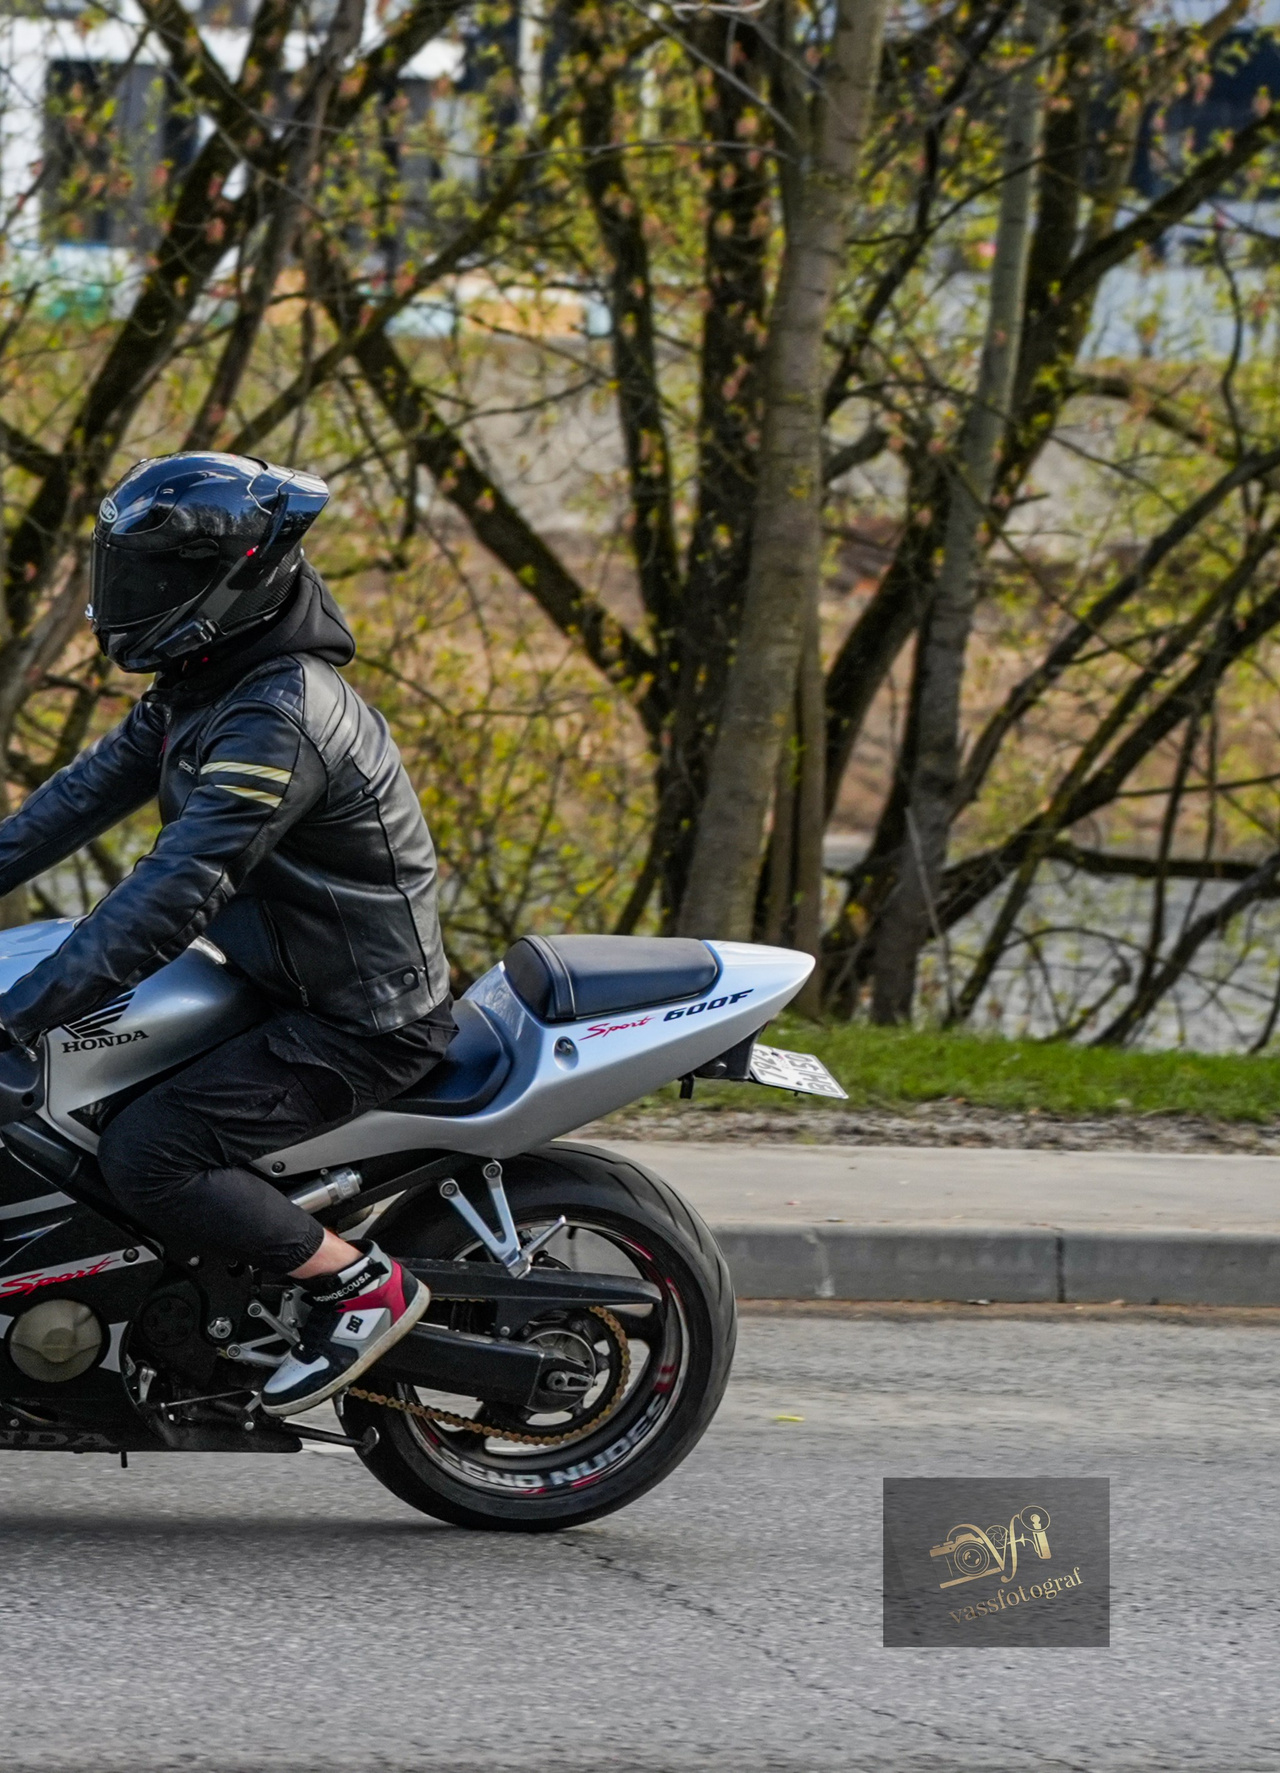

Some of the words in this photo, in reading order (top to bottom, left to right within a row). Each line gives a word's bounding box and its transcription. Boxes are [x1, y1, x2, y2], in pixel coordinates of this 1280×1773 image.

[62, 1028, 150, 1054] HONDA
[579, 1016, 655, 1041] Sport
[663, 988, 754, 1022] 600F
[549, 1393, 666, 1485] NUDES
